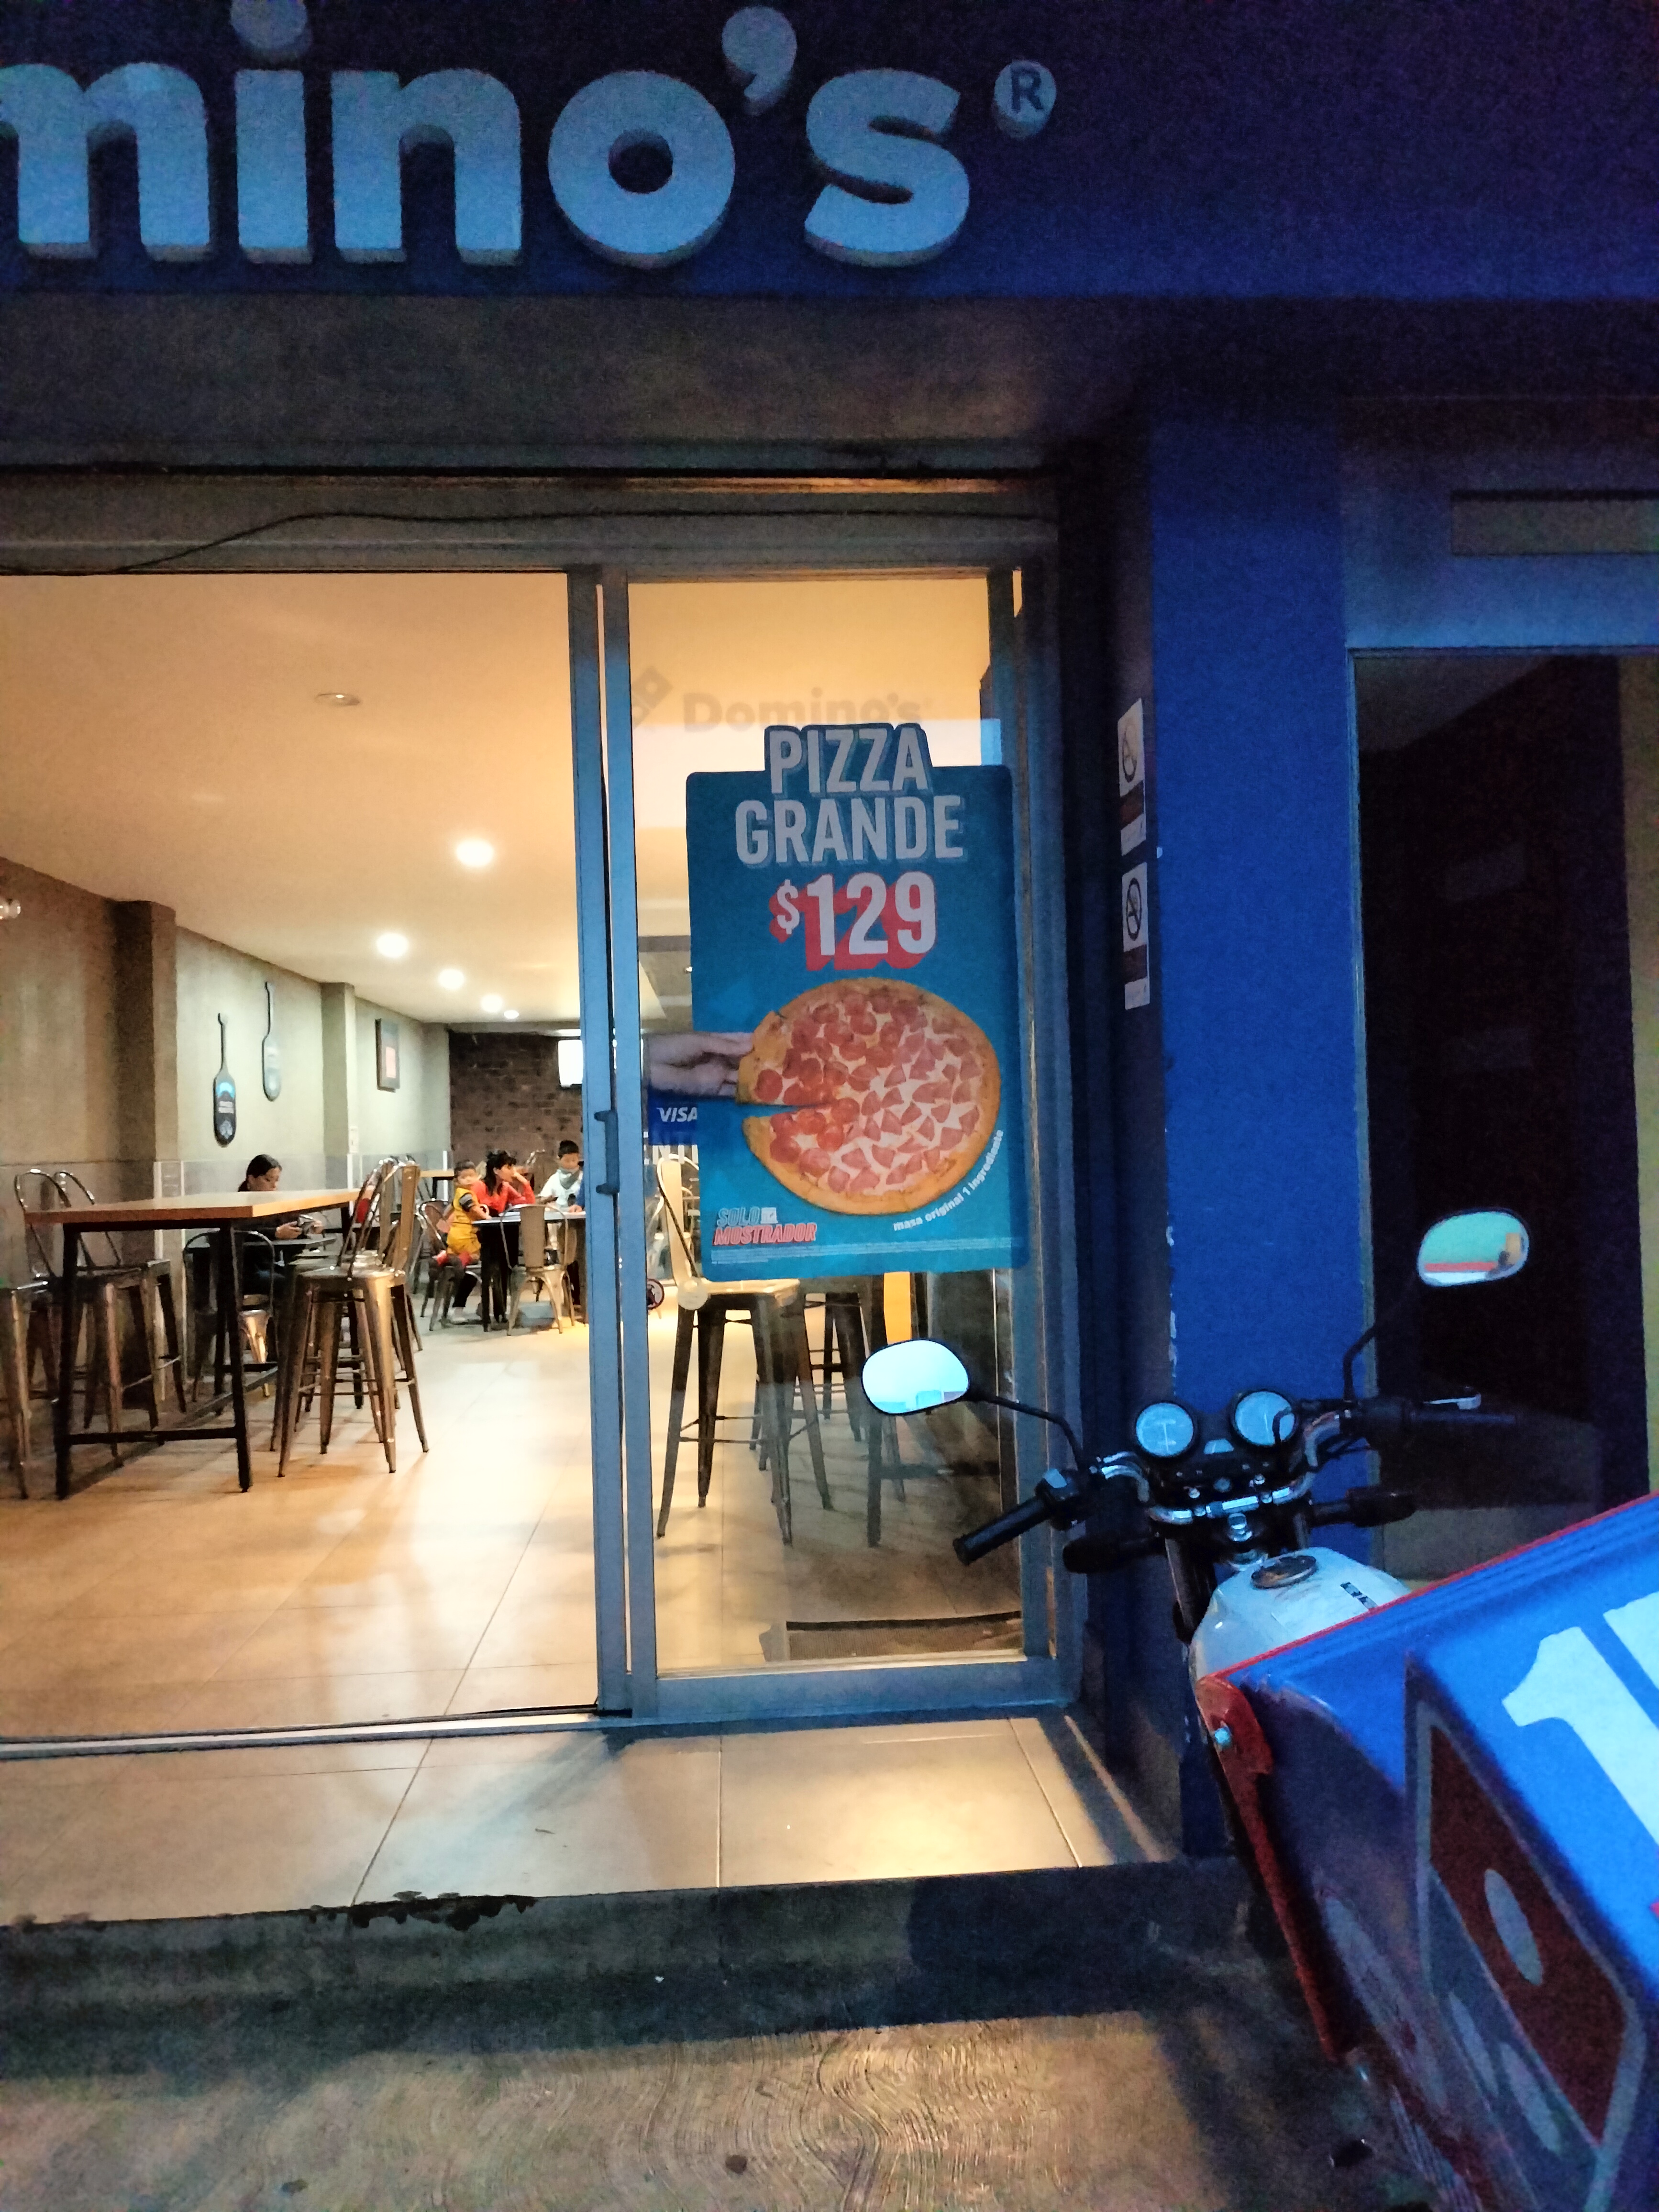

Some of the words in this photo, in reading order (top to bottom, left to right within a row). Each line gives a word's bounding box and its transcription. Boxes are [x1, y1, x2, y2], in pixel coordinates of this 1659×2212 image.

[683, 686, 921, 733] Domino's
[770, 726, 929, 796] PIZZA
[734, 794, 965, 867] GRANDE
[772, 871, 938, 960] $129
[656, 1106, 698, 1122] VISA
[893, 1217, 923, 1231] masa
[925, 1192, 964, 1222] original
[962, 1186, 971, 1195] 1
[968, 1129, 1004, 1191] ingrediente
[712, 1222, 818, 1246] MOSTRADOR
[716, 1206, 761, 1227] SOLO
